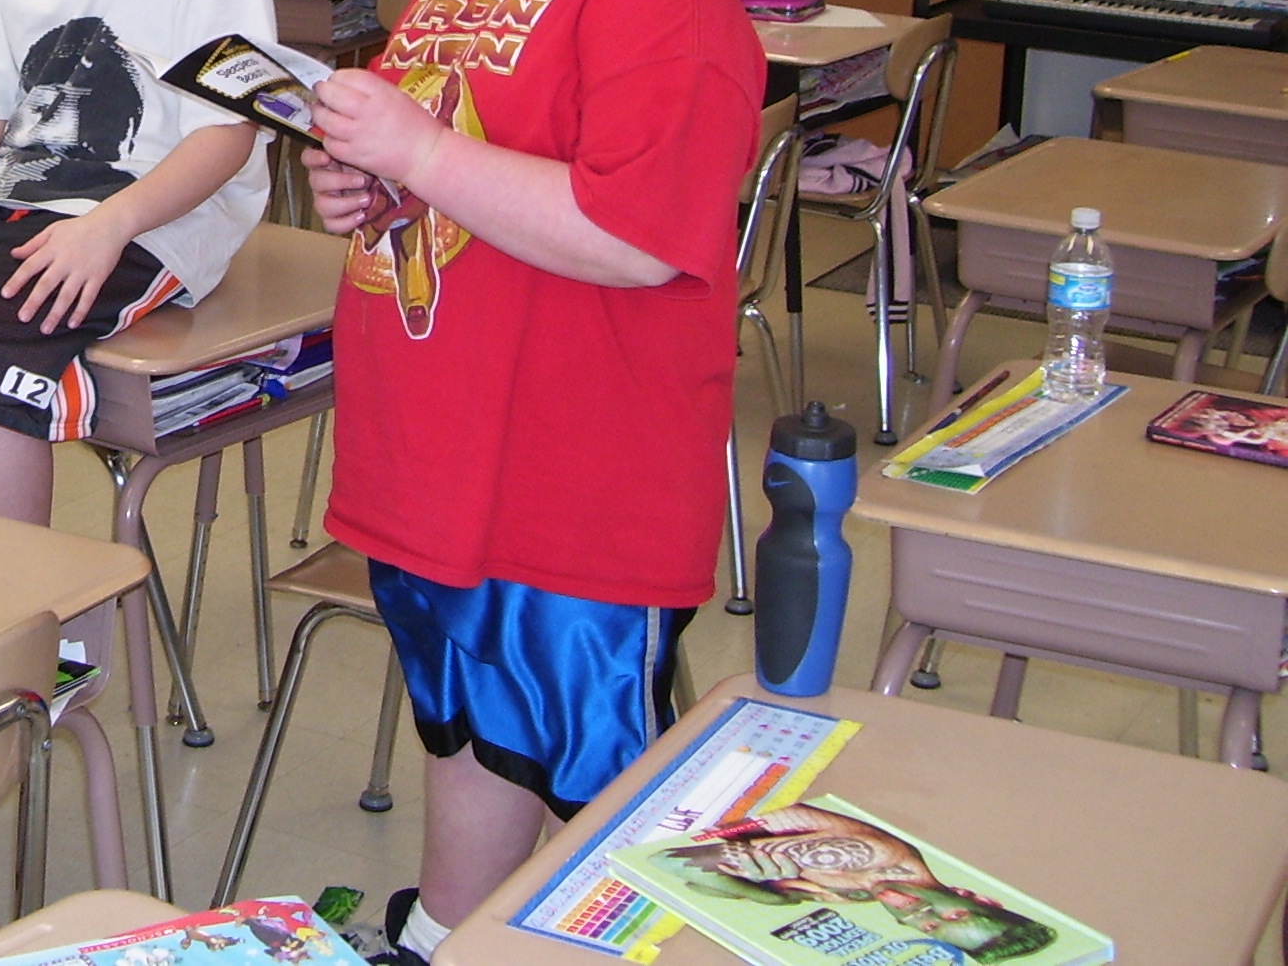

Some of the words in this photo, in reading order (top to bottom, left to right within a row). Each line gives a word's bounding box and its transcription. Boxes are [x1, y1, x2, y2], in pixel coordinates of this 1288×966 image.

[381, 30, 528, 76] MAN
[8, 371, 49, 405] 12
[792, 916, 854, 947] 2009
